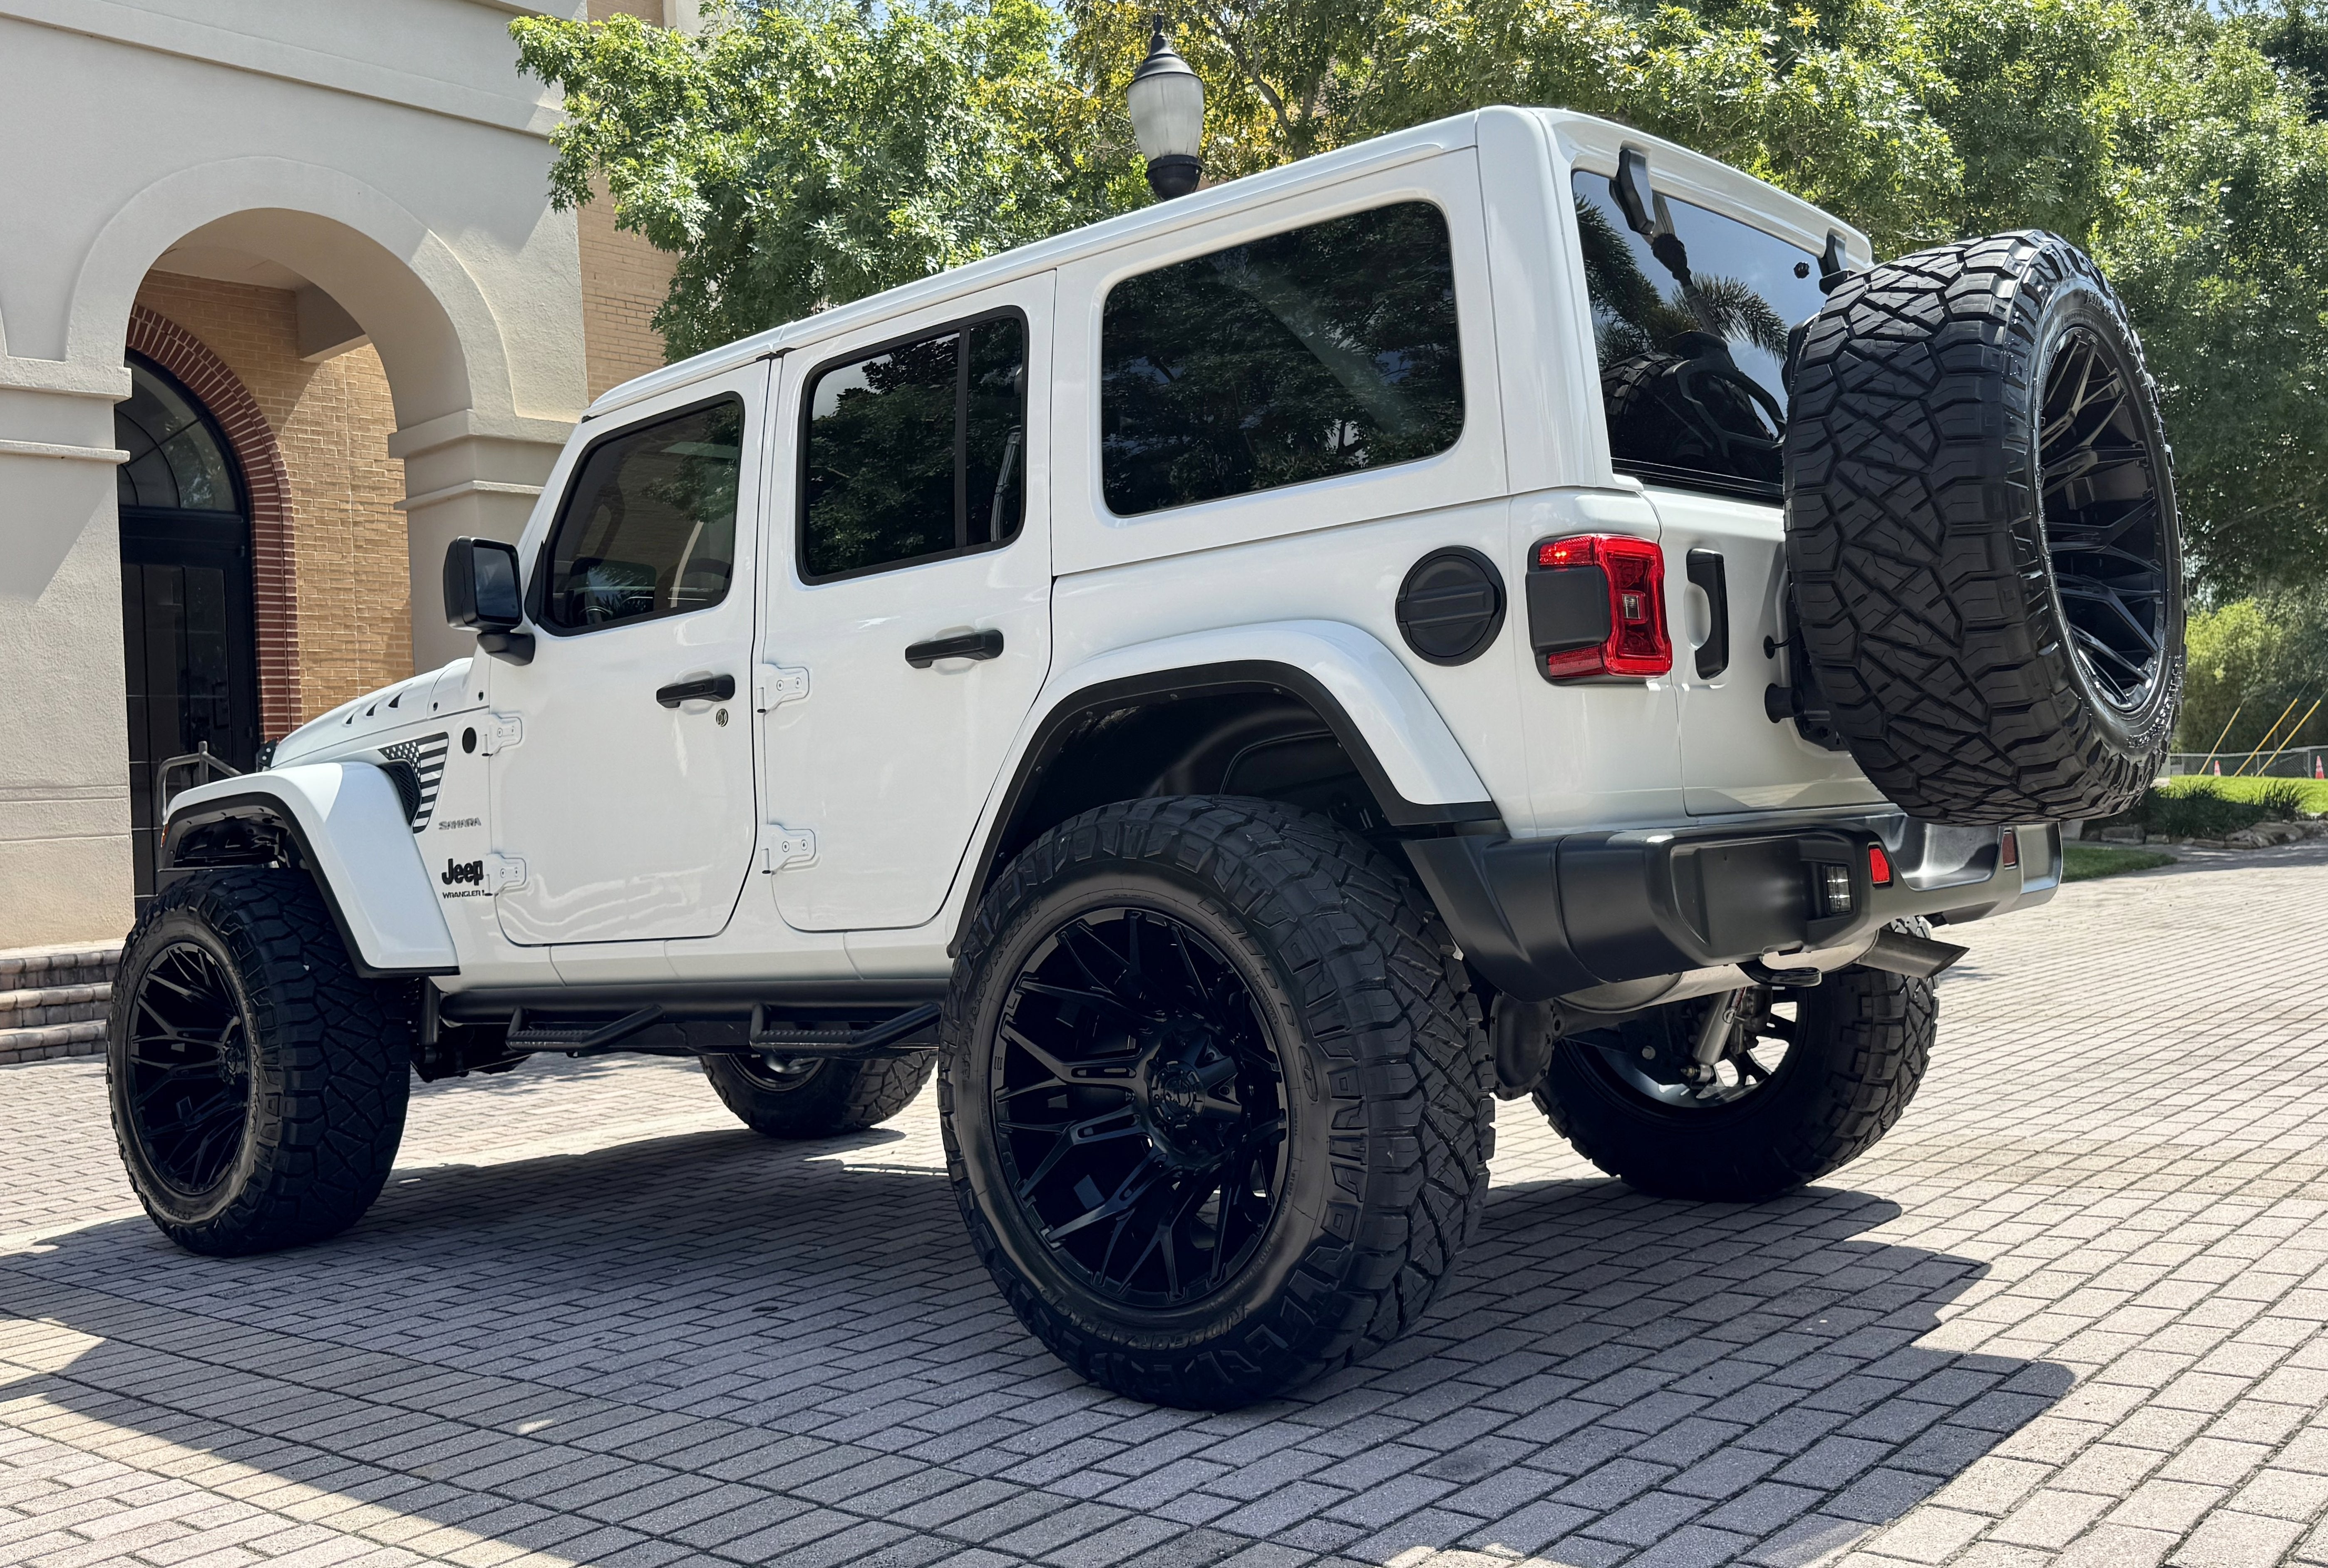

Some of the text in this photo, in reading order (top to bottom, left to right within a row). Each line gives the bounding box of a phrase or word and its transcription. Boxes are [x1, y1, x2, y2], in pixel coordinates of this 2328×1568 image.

[439, 817, 481, 830] SAHARA
[442, 858, 484, 886] Jeep
[442, 890, 481, 899] WRANGLER
